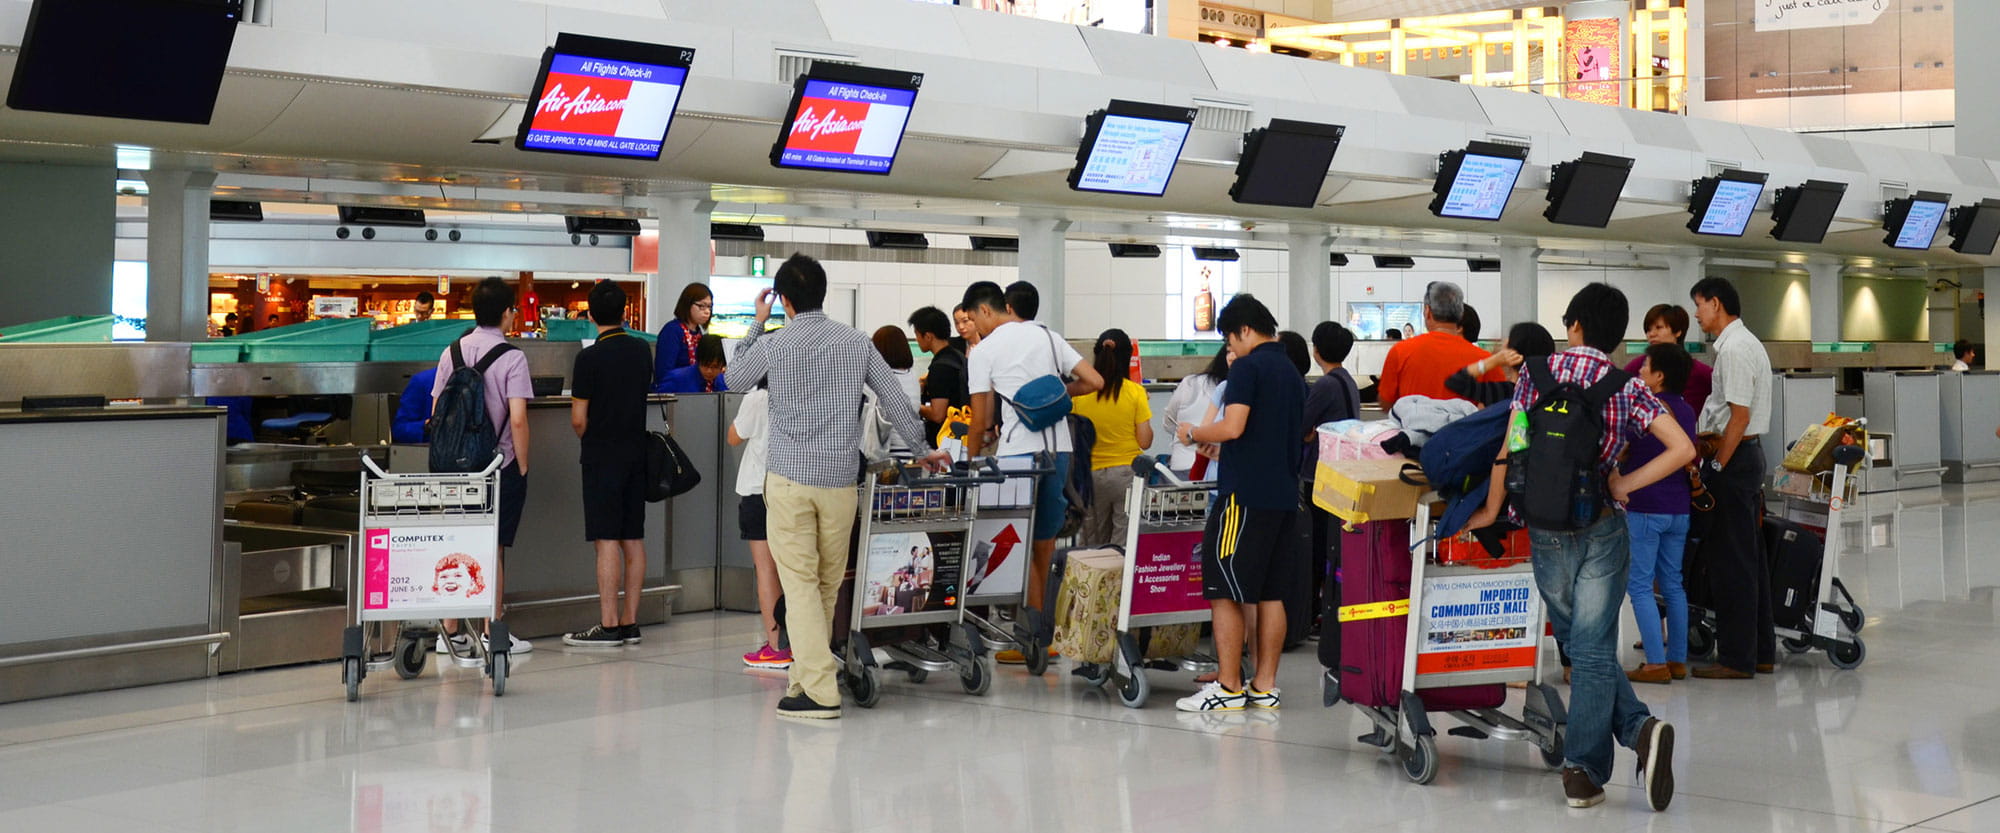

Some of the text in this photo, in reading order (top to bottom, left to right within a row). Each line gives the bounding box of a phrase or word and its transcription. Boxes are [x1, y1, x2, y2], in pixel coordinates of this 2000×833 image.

[1775, 1, 1797, 19] just
[680, 51, 692, 61] P2
[580, 62, 652, 79] All Flights Check-in
[911, 75, 921, 85] P3
[828, 86, 887, 101] All Flights Check-in
[536, 134, 550, 143] GATE
[551, 135, 575, 145] APPROX.
[577, 138, 586, 146] TO
[586, 138, 593, 146] 40
[593, 139, 608, 148] MINS
[608, 141, 618, 149] ALL
[619, 141, 635, 150] GATE
[392, 535, 444, 543] COMPUTEX
[1152, 553, 1170, 562] Indian
[1135, 565, 1157, 573] Fashion
[1158, 563, 1186, 572] Jewellery
[1144, 573, 1179, 583] Accessories
[1150, 585, 1166, 593] Show
[1432, 579, 1529, 591] YIWU CHINA COMMODITY CITY
[1480, 588, 1529, 602] IMPORTED
[1431, 601, 1527, 618] COMMODITIES MALL
